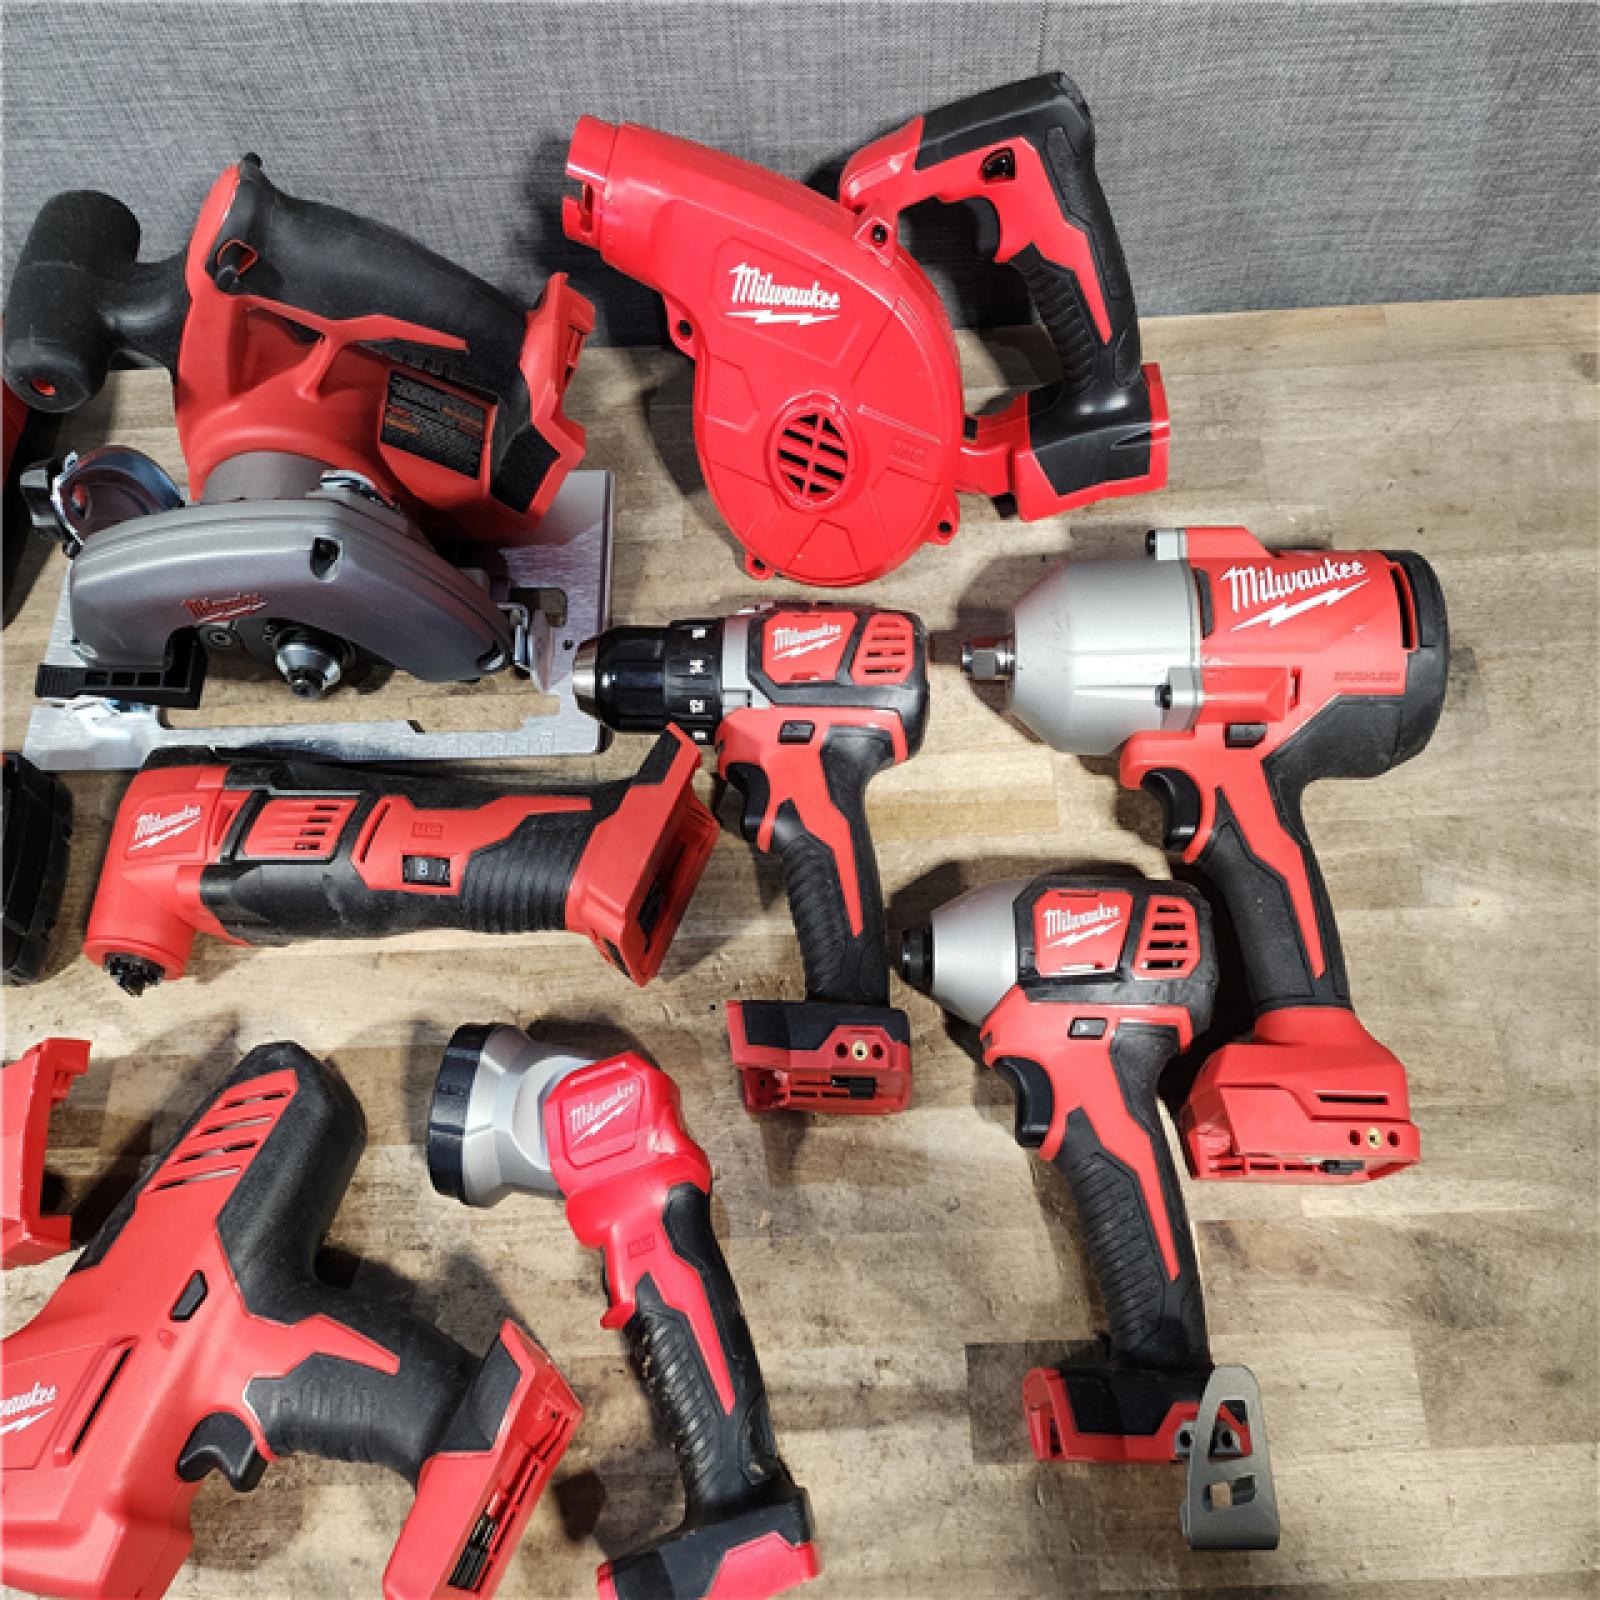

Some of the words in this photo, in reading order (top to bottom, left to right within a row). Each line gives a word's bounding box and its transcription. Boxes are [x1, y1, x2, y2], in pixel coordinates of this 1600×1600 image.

[729, 263, 840, 309] Milwaukee
[1220, 558, 1367, 613] Milwaukee
[773, 623, 841, 650] Milwaukee
[134, 804, 201, 840] Milwaukee
[1042, 903, 1120, 938] Milwaukee
[569, 1081, 635, 1135] Milwaukee
